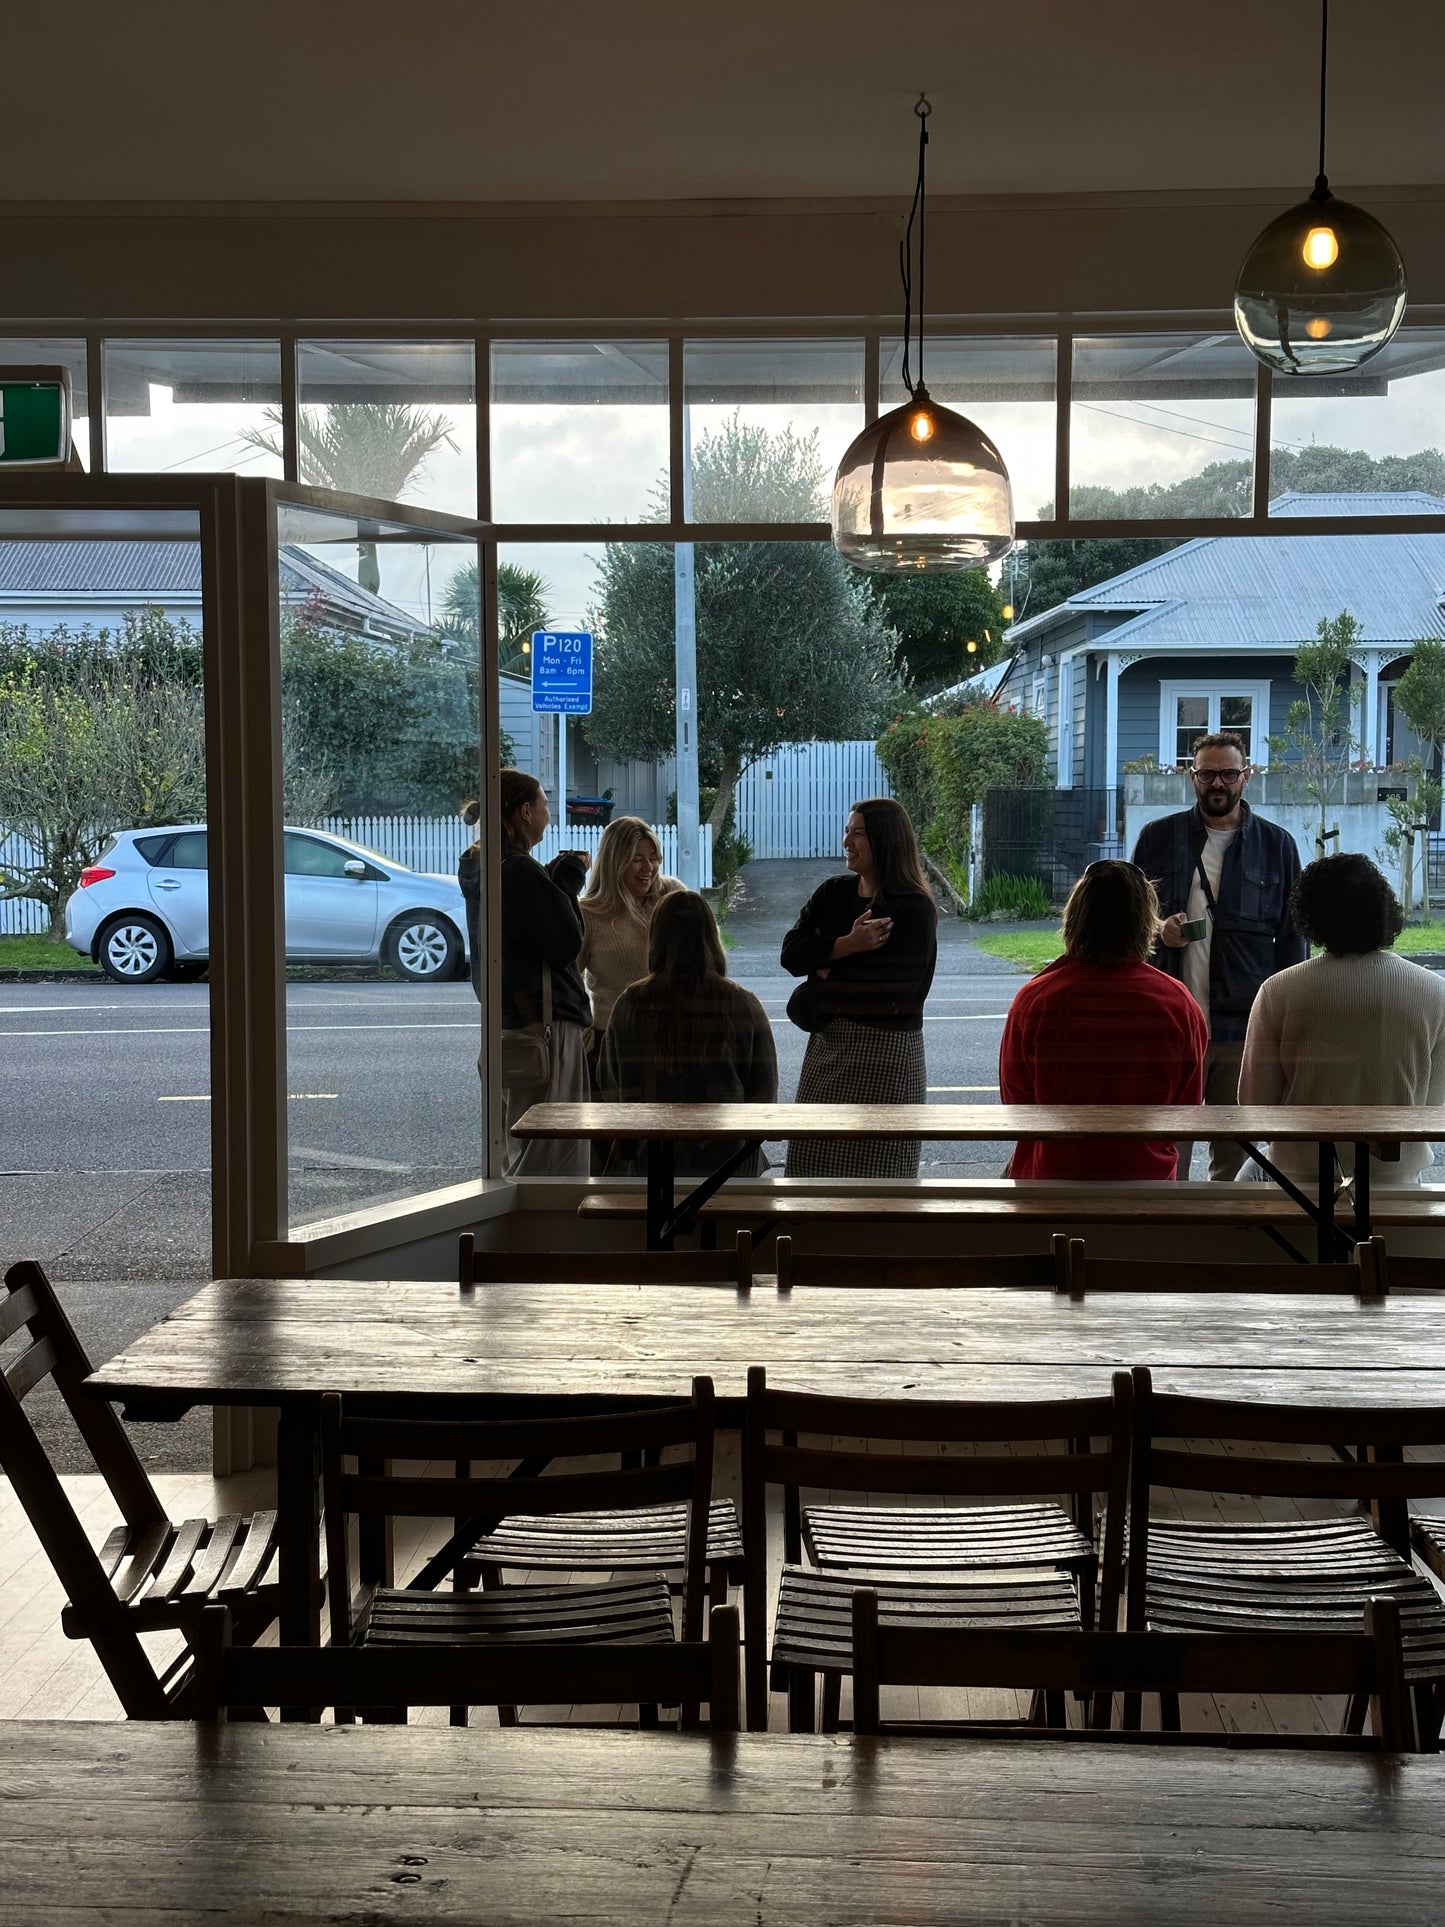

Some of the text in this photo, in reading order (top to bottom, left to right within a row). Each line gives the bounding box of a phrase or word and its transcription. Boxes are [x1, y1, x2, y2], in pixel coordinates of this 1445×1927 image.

[543, 656, 561, 665] Mon
[570, 656, 582, 665] Fri
[540, 666, 557, 675] 8am
[566, 667, 585, 676] 6pm
[564, 703, 588, 711] Exempt
